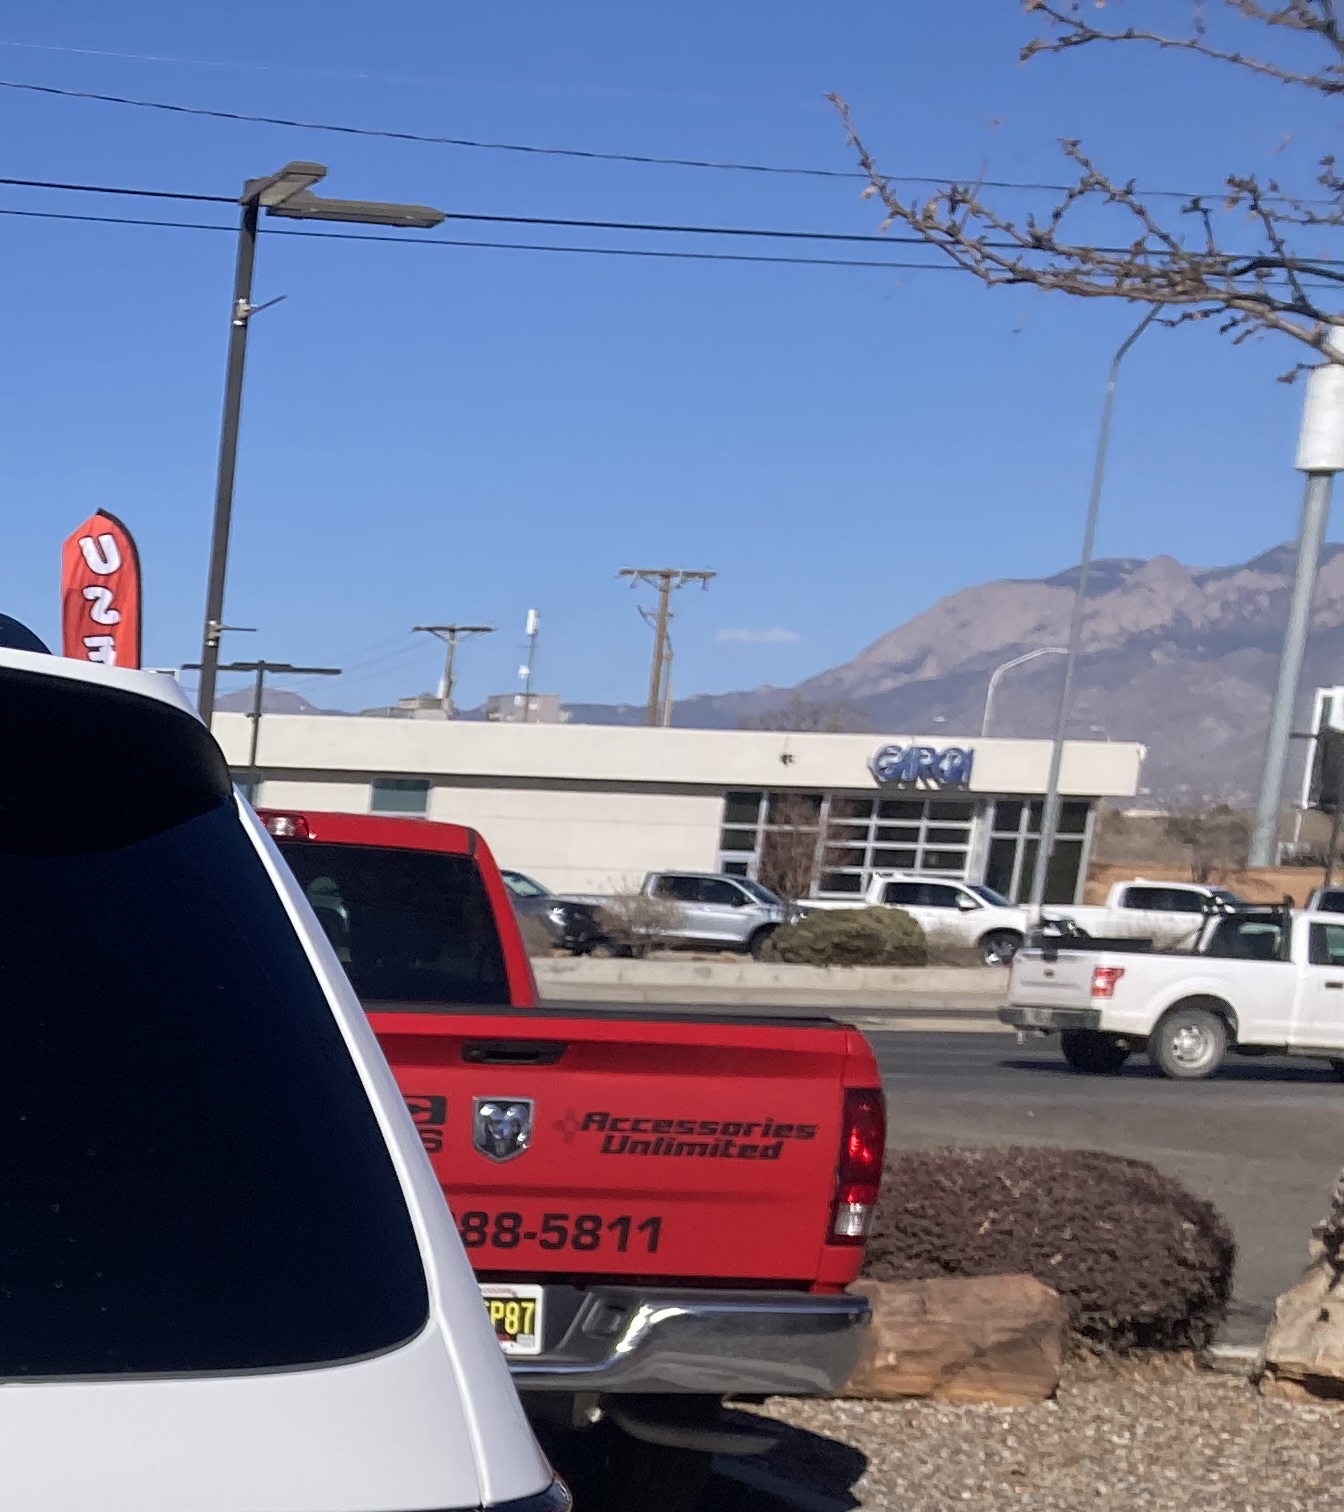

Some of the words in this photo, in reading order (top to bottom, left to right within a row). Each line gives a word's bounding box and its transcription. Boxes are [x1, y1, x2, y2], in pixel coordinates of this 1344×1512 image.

[579, 1110, 819, 1140] Accessories
[600, 1134, 784, 1160] Unlimited
[453, 1211, 663, 1253] 88-5811
[483, 1300, 535, 1335] P87
